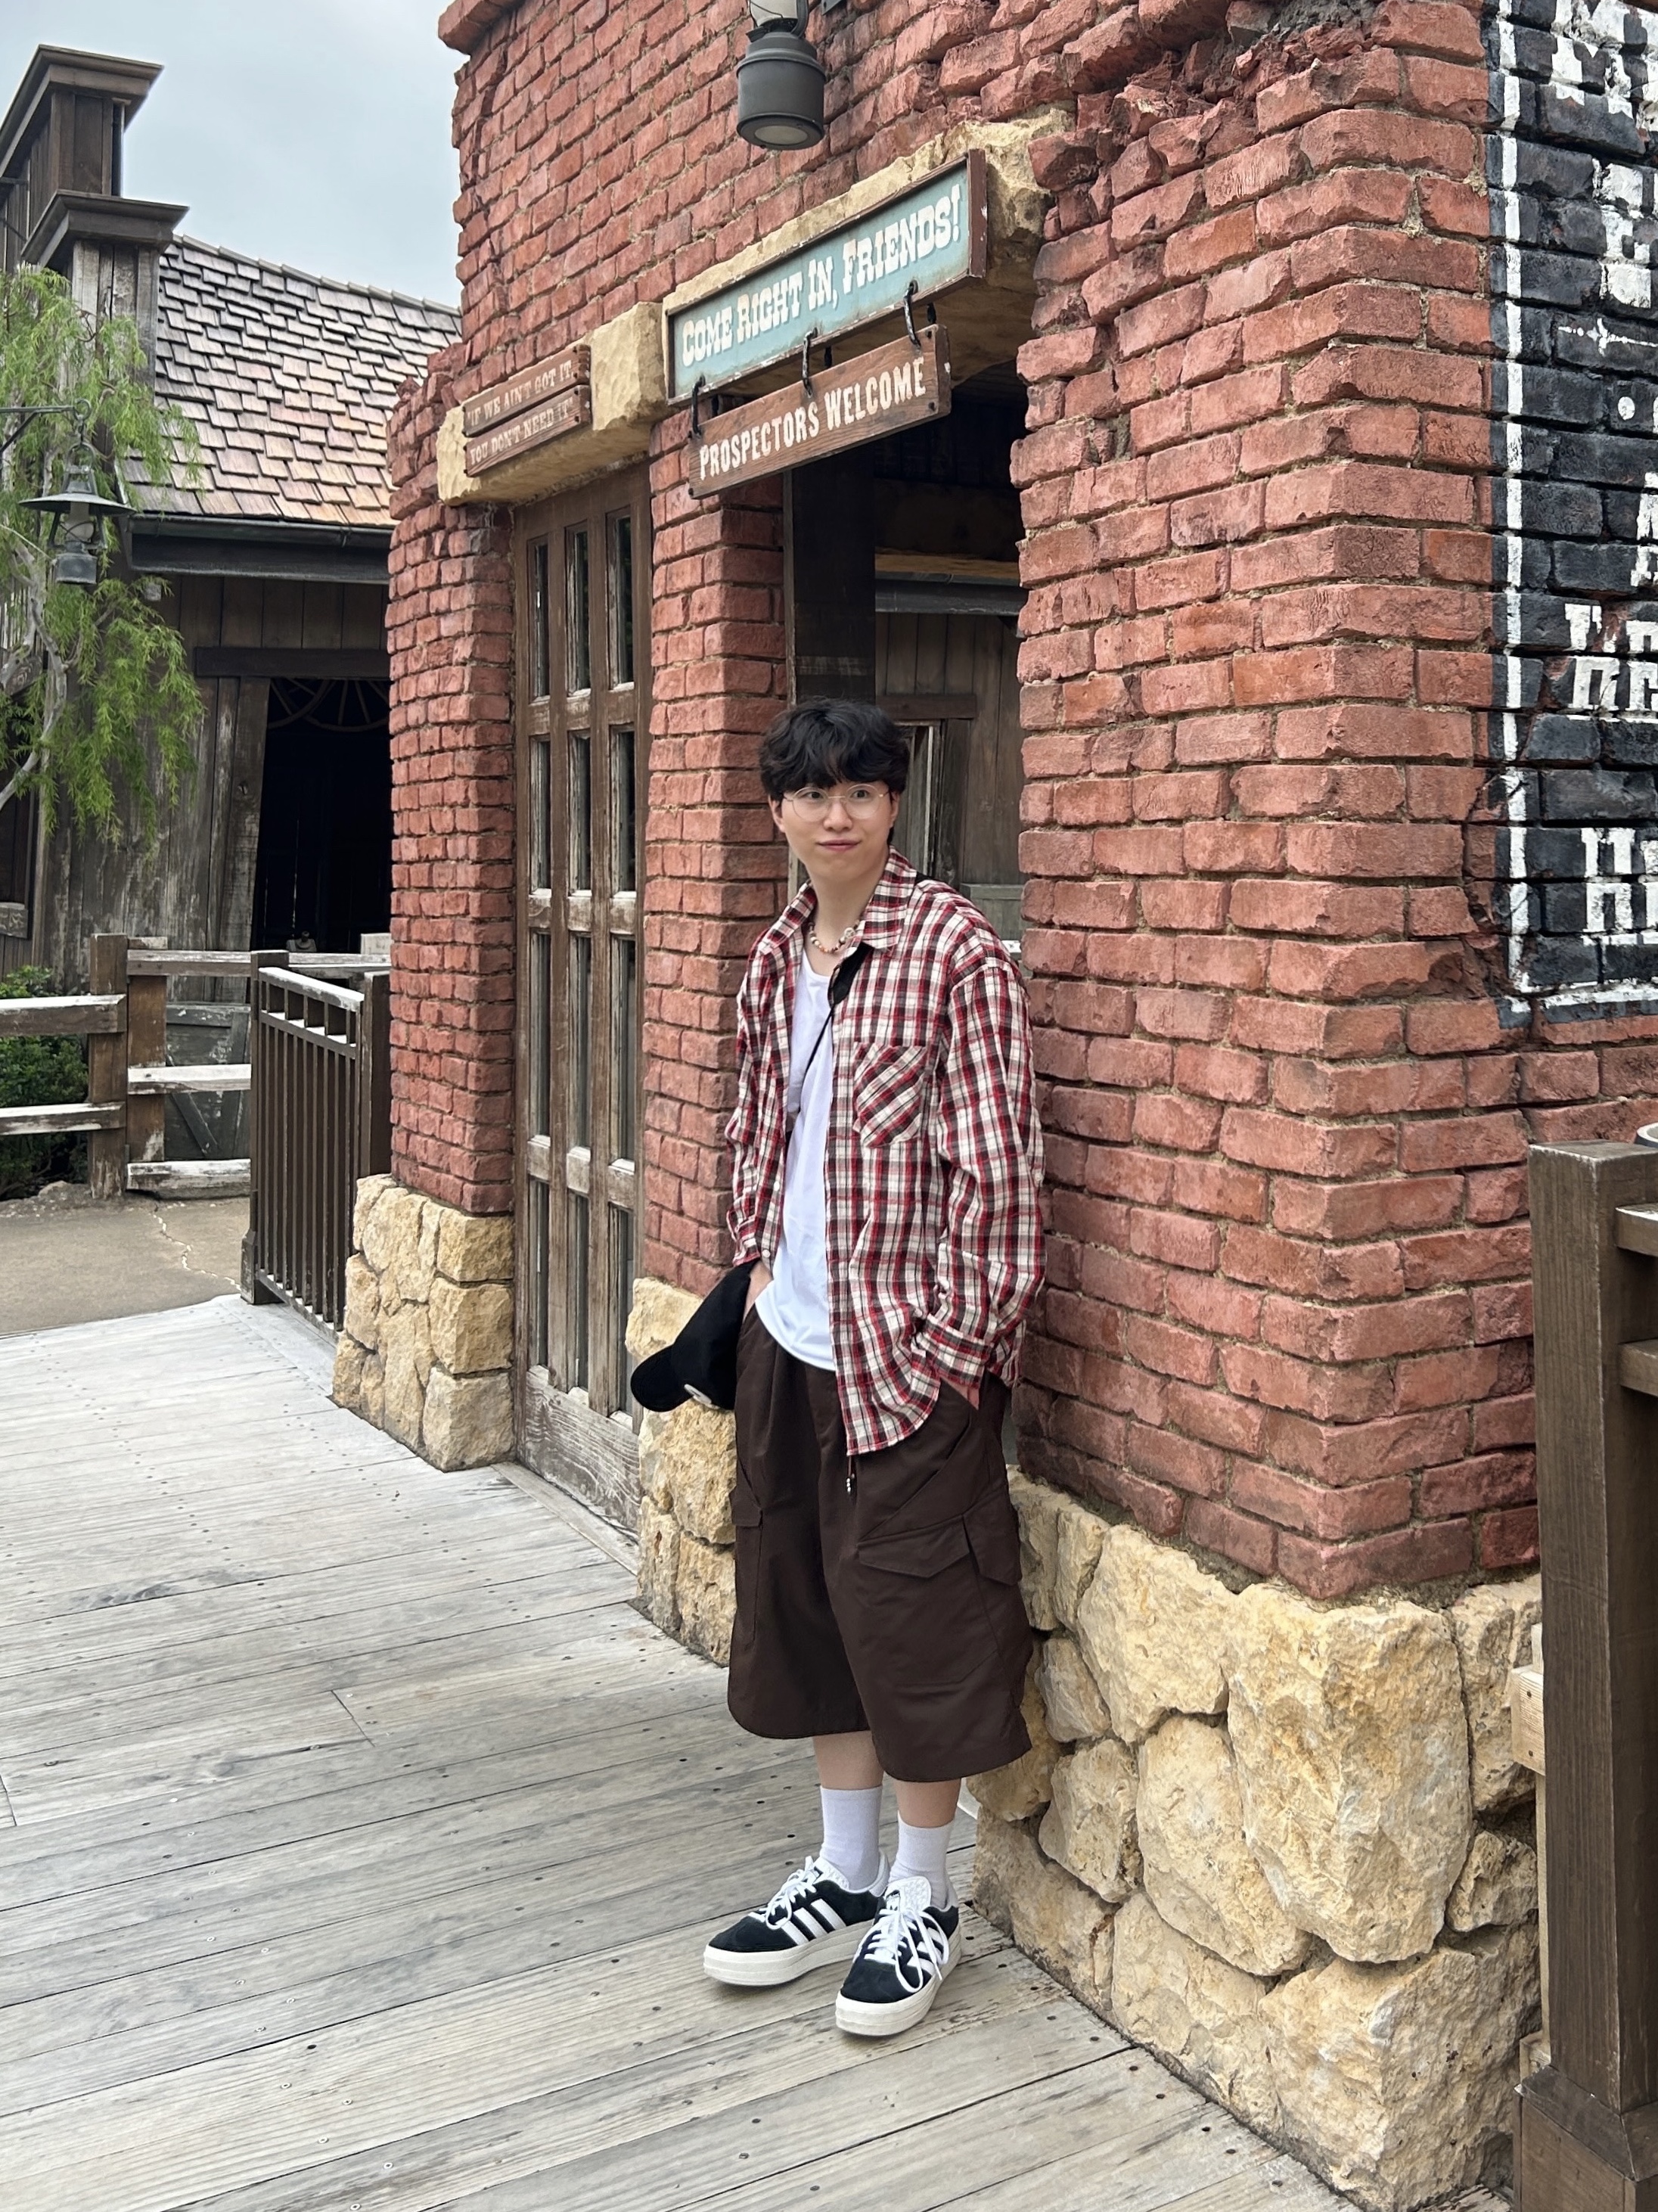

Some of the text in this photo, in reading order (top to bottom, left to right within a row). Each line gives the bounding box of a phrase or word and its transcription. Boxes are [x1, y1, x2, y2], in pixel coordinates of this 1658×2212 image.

[682, 184, 961, 367] COME RIGHT IN, FRIENDS!
[470, 443, 488, 465] YOU
[523, 408, 555, 440] NEED
[483, 399, 501, 420] WE
[535, 368, 556, 394] GOT
[700, 357, 927, 481] PROSPECTORS WELCOME
